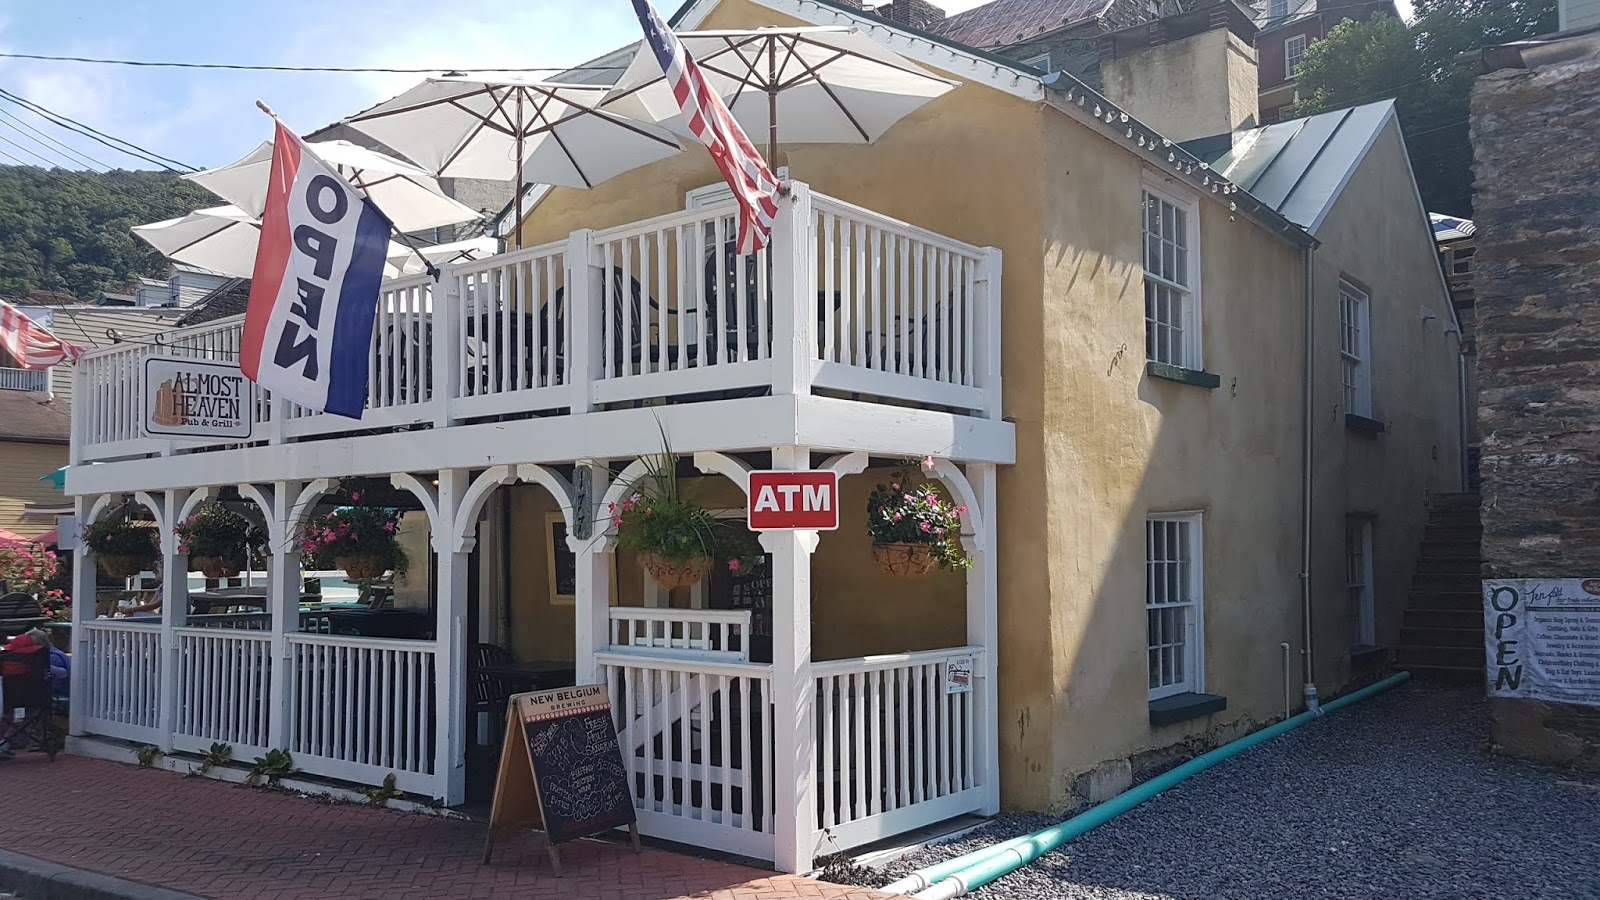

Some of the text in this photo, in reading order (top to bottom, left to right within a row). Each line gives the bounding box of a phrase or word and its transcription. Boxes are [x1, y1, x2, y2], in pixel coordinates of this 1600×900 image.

[172, 371, 243, 398] ALMOST
[172, 394, 240, 420] HEAVEN
[181, 417, 233, 428] Pub & Grill
[753, 484, 831, 513] ATM
[1491, 586, 1522, 691] OPEN
[530, 686, 601, 706] NEW BELGIUM
[550, 699, 587, 711] BREWING
[584, 715, 608, 730] FRESH
[546, 737, 569, 766] CRAB
[585, 739, 619, 756] SANGRIAS
[558, 752, 571, 771] DIP
